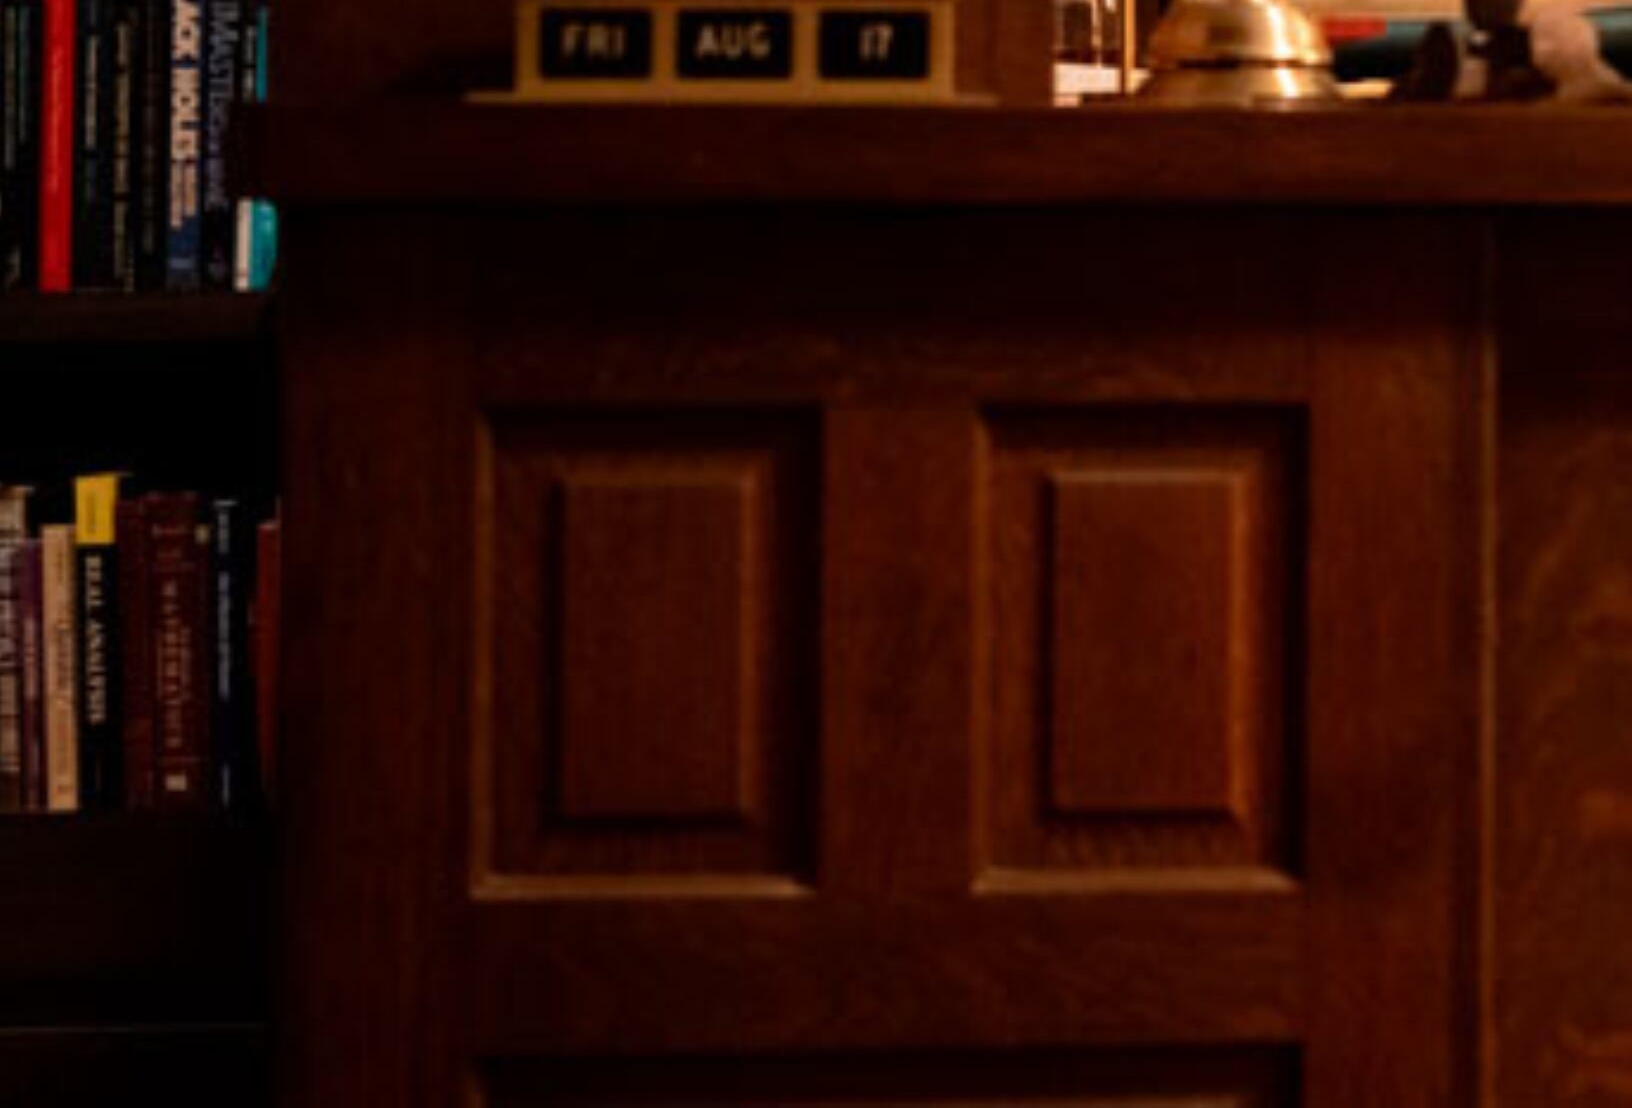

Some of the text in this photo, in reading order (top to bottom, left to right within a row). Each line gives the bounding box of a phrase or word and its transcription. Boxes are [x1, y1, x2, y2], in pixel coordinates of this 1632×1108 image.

[559, 22, 895, 61] FRI AUG 17
[170, 67, 200, 161] HOLES
[85, 553, 104, 608] REAL
[86, 619, 107, 726] ANALYSIS
